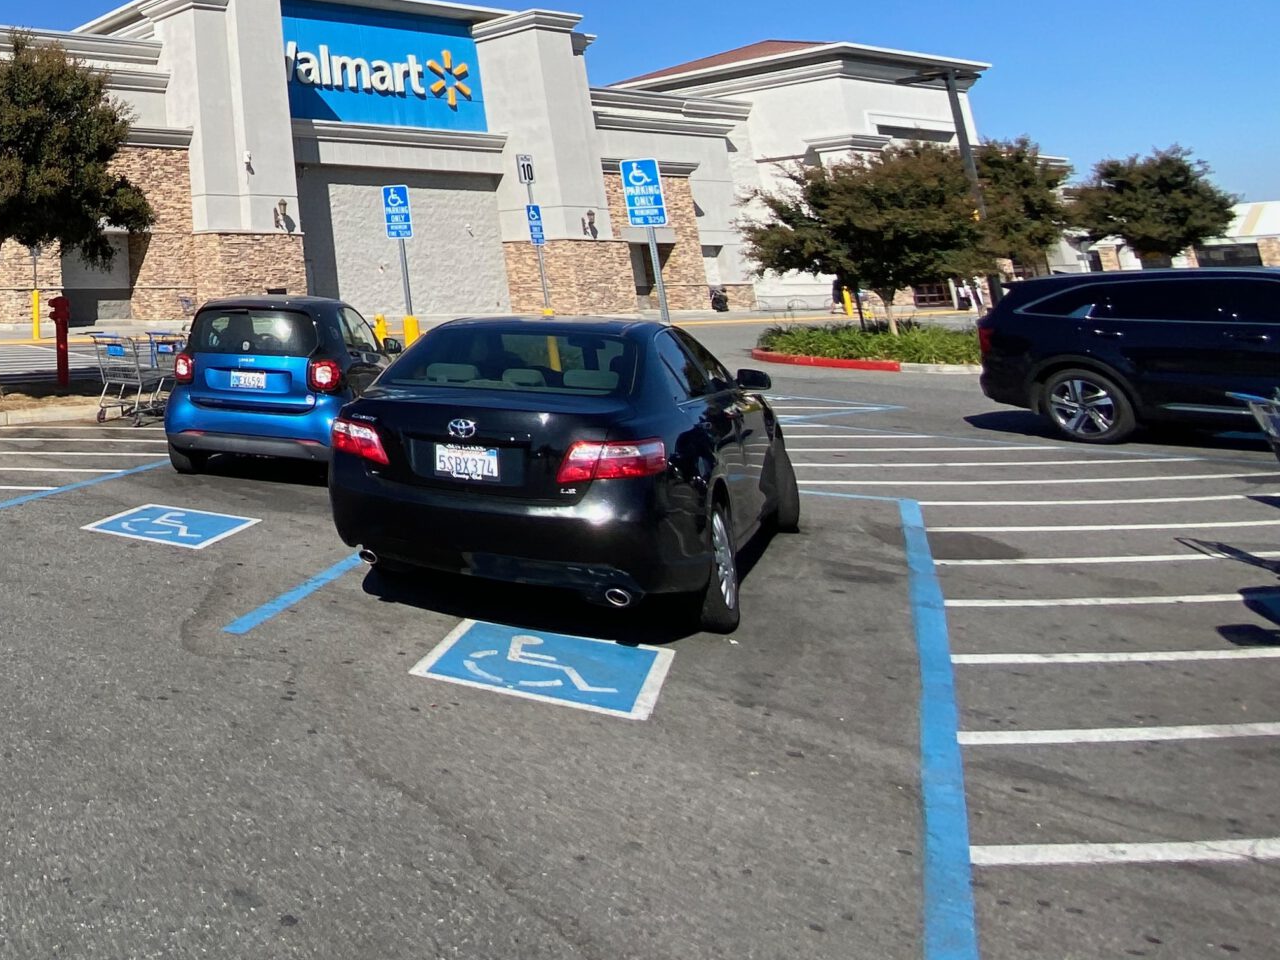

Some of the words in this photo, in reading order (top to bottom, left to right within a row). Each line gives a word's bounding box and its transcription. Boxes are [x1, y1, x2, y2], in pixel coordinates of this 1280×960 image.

[521, 163, 534, 181] 10
[624, 184, 660, 196] PARKING
[634, 196, 654, 206] ONLY
[439, 455, 494, 476] 5SBX374
